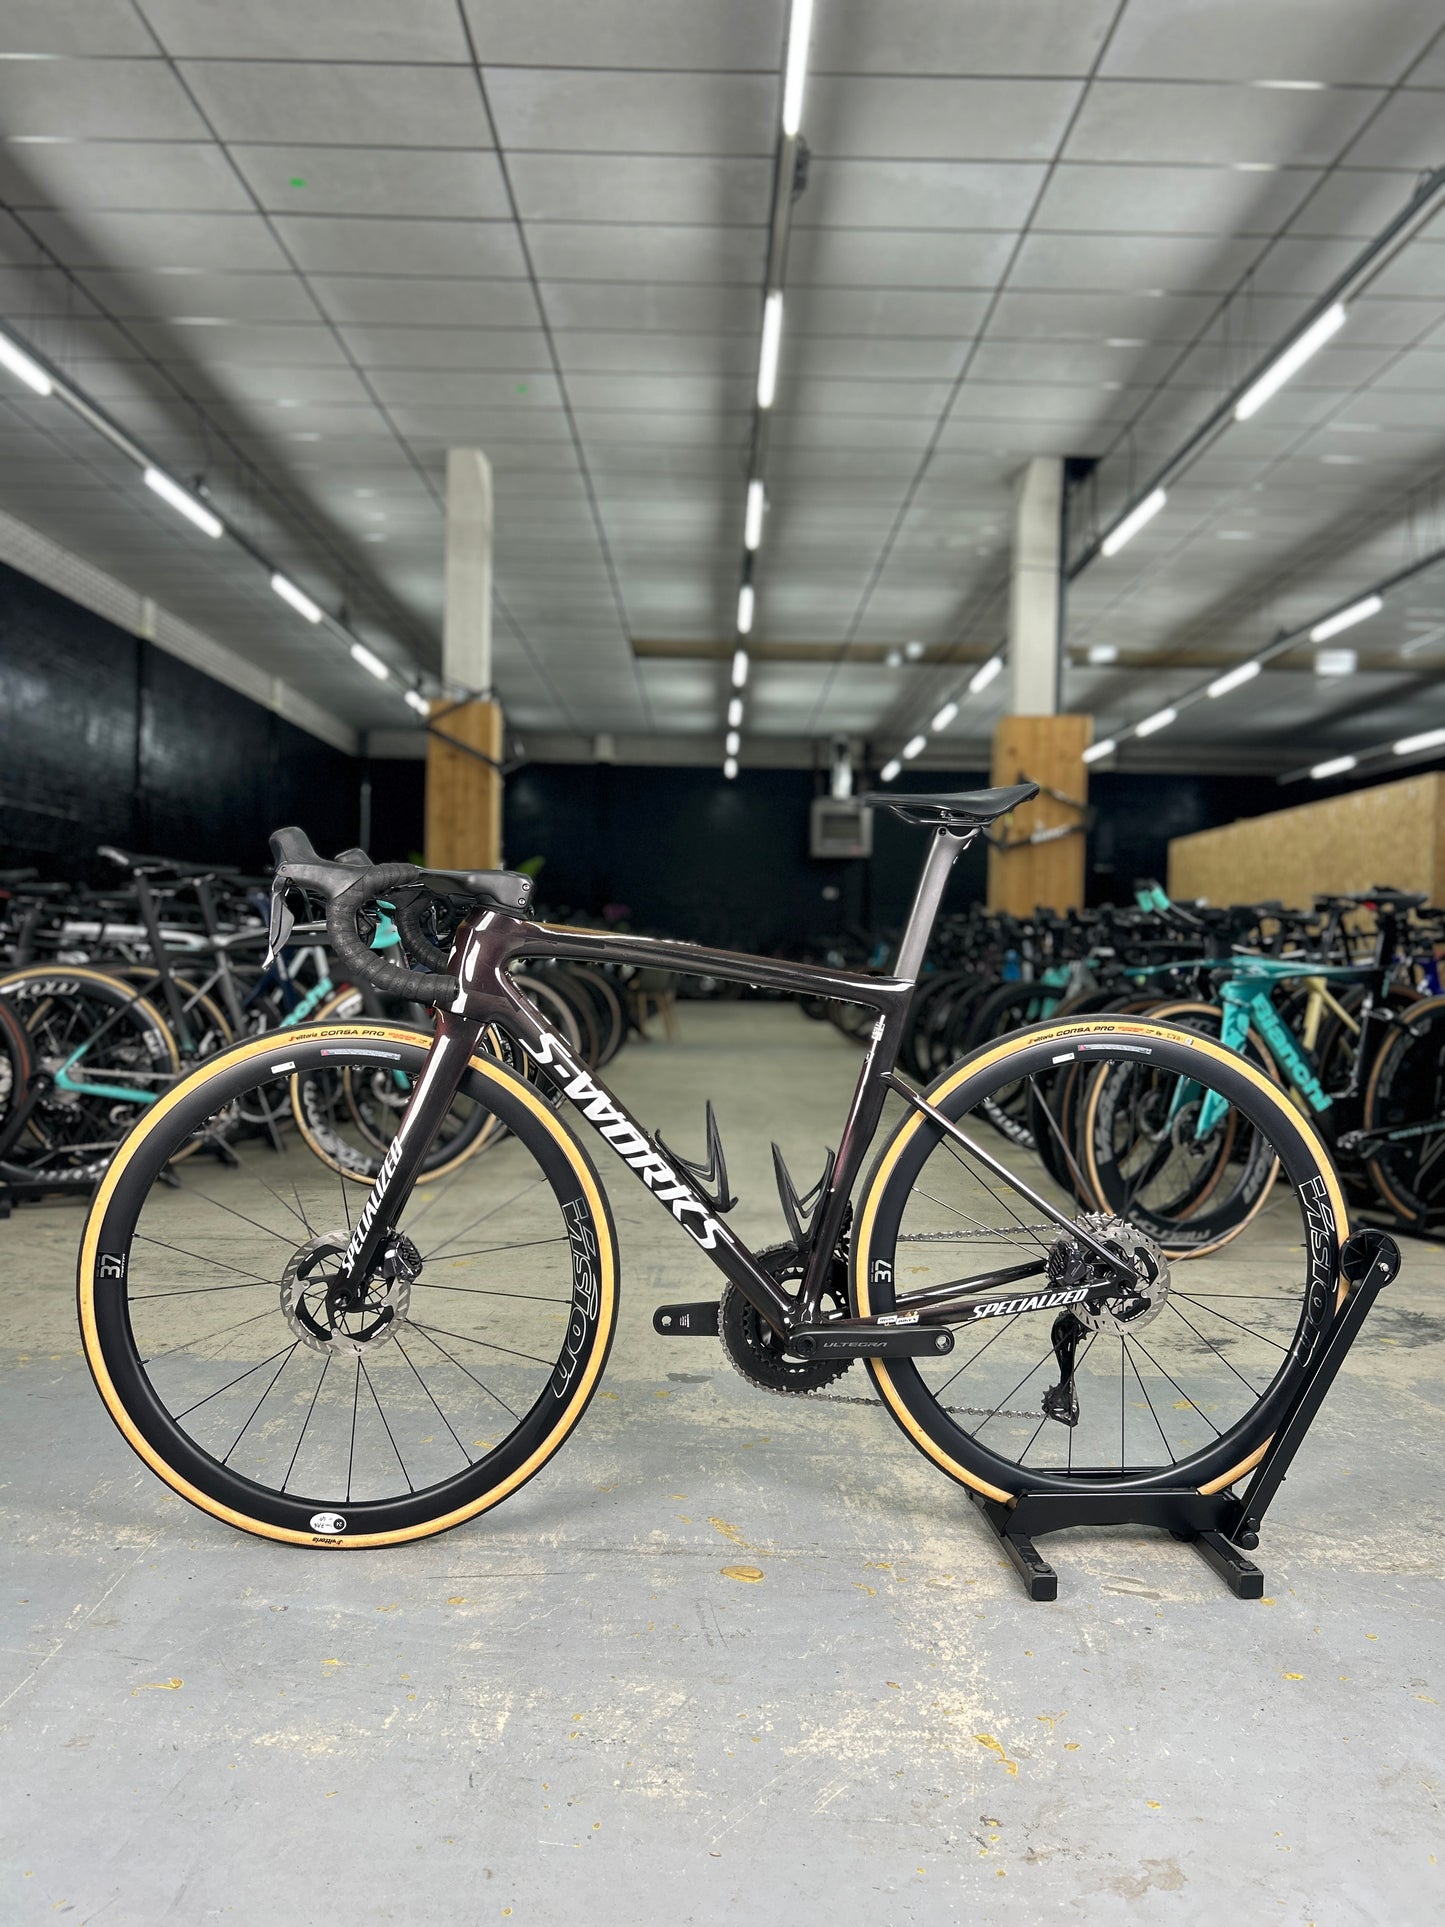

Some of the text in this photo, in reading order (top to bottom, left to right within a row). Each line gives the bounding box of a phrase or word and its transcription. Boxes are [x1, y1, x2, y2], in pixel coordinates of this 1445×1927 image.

[320, 1029, 359, 1037] CORSA
[361, 1029, 386, 1037] PRO
[1056, 1026, 1091, 1037] CORSA
[1252, 993, 1333, 1113] Bianchi
[519, 1033, 734, 1250] S-WORKS
[341, 1135, 403, 1279] SPECIALIZED
[100, 1254, 121, 1279] 37
[874, 1259, 892, 1283] 37
[967, 1289, 1089, 1321] SPECIALIZED
